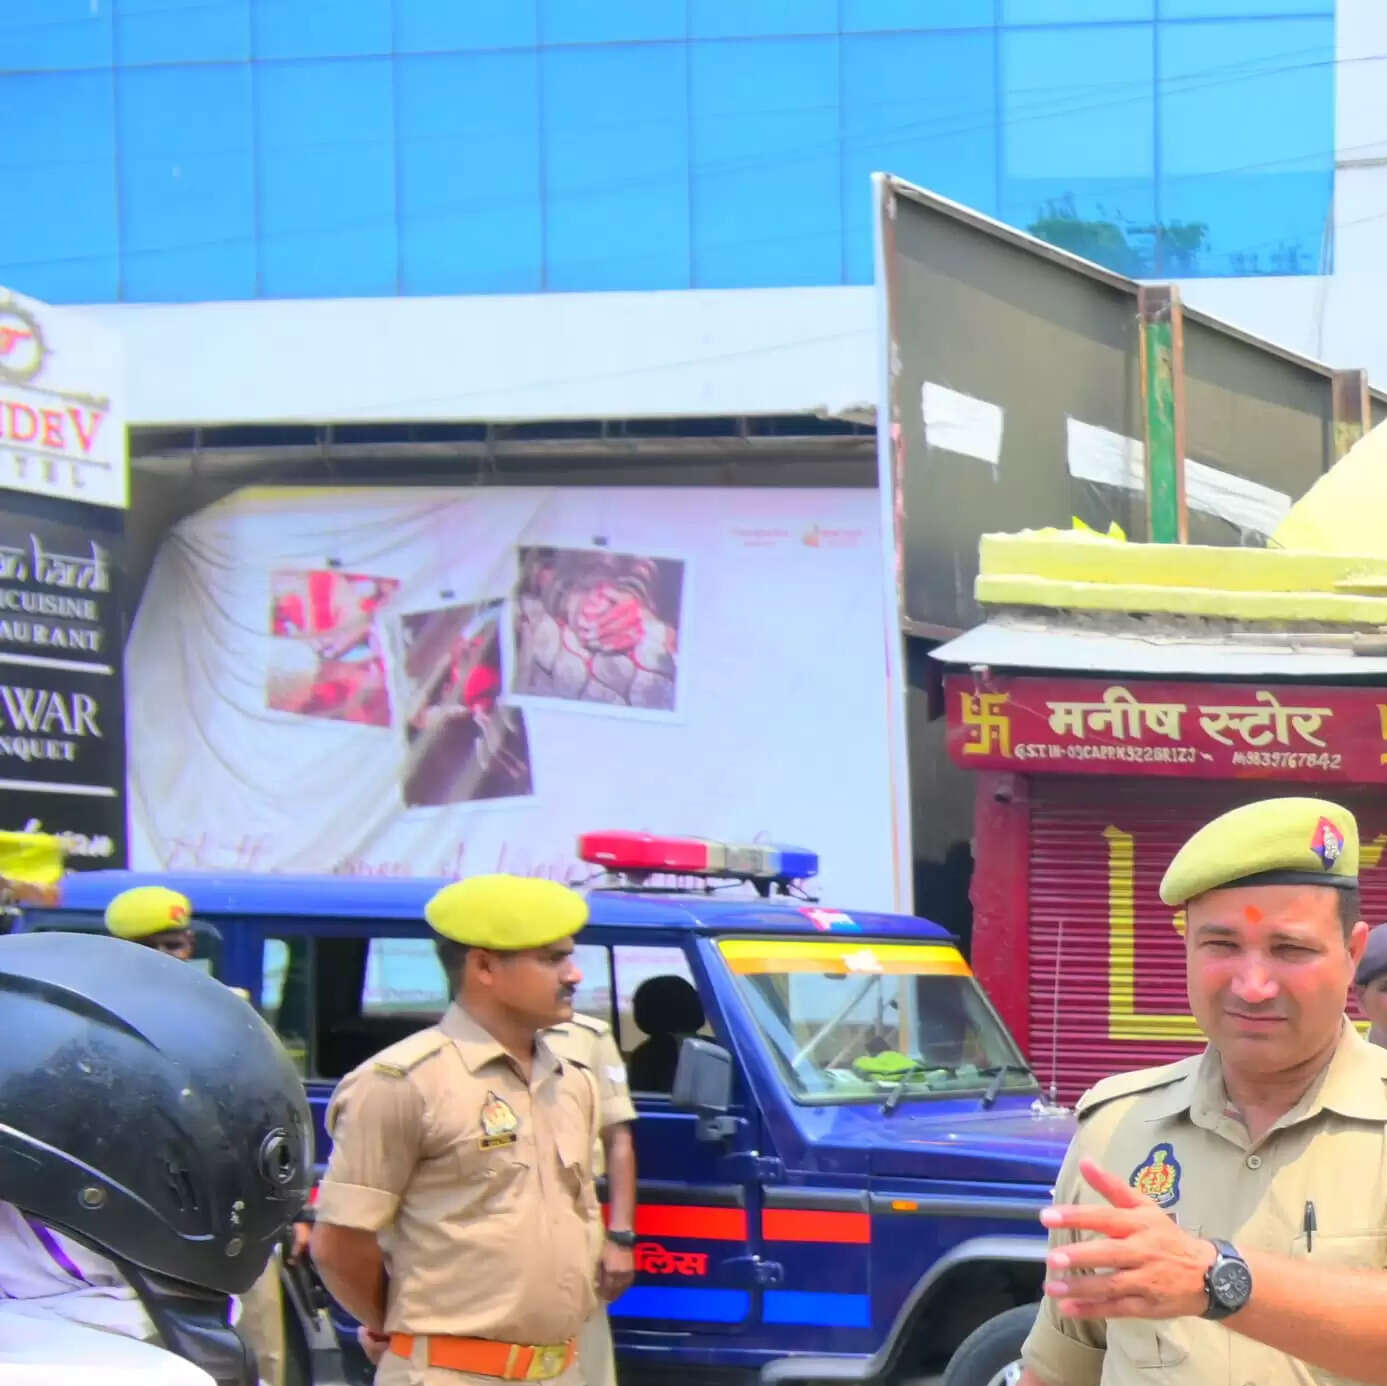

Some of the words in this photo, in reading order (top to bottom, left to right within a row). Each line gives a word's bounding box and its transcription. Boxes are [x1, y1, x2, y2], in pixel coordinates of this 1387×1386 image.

[0, 400, 103, 453] DEV
[0, 685, 103, 738] WAR
[1046, 686, 1187, 740] मनीष
[1198, 690, 1334, 748] स्टोर
